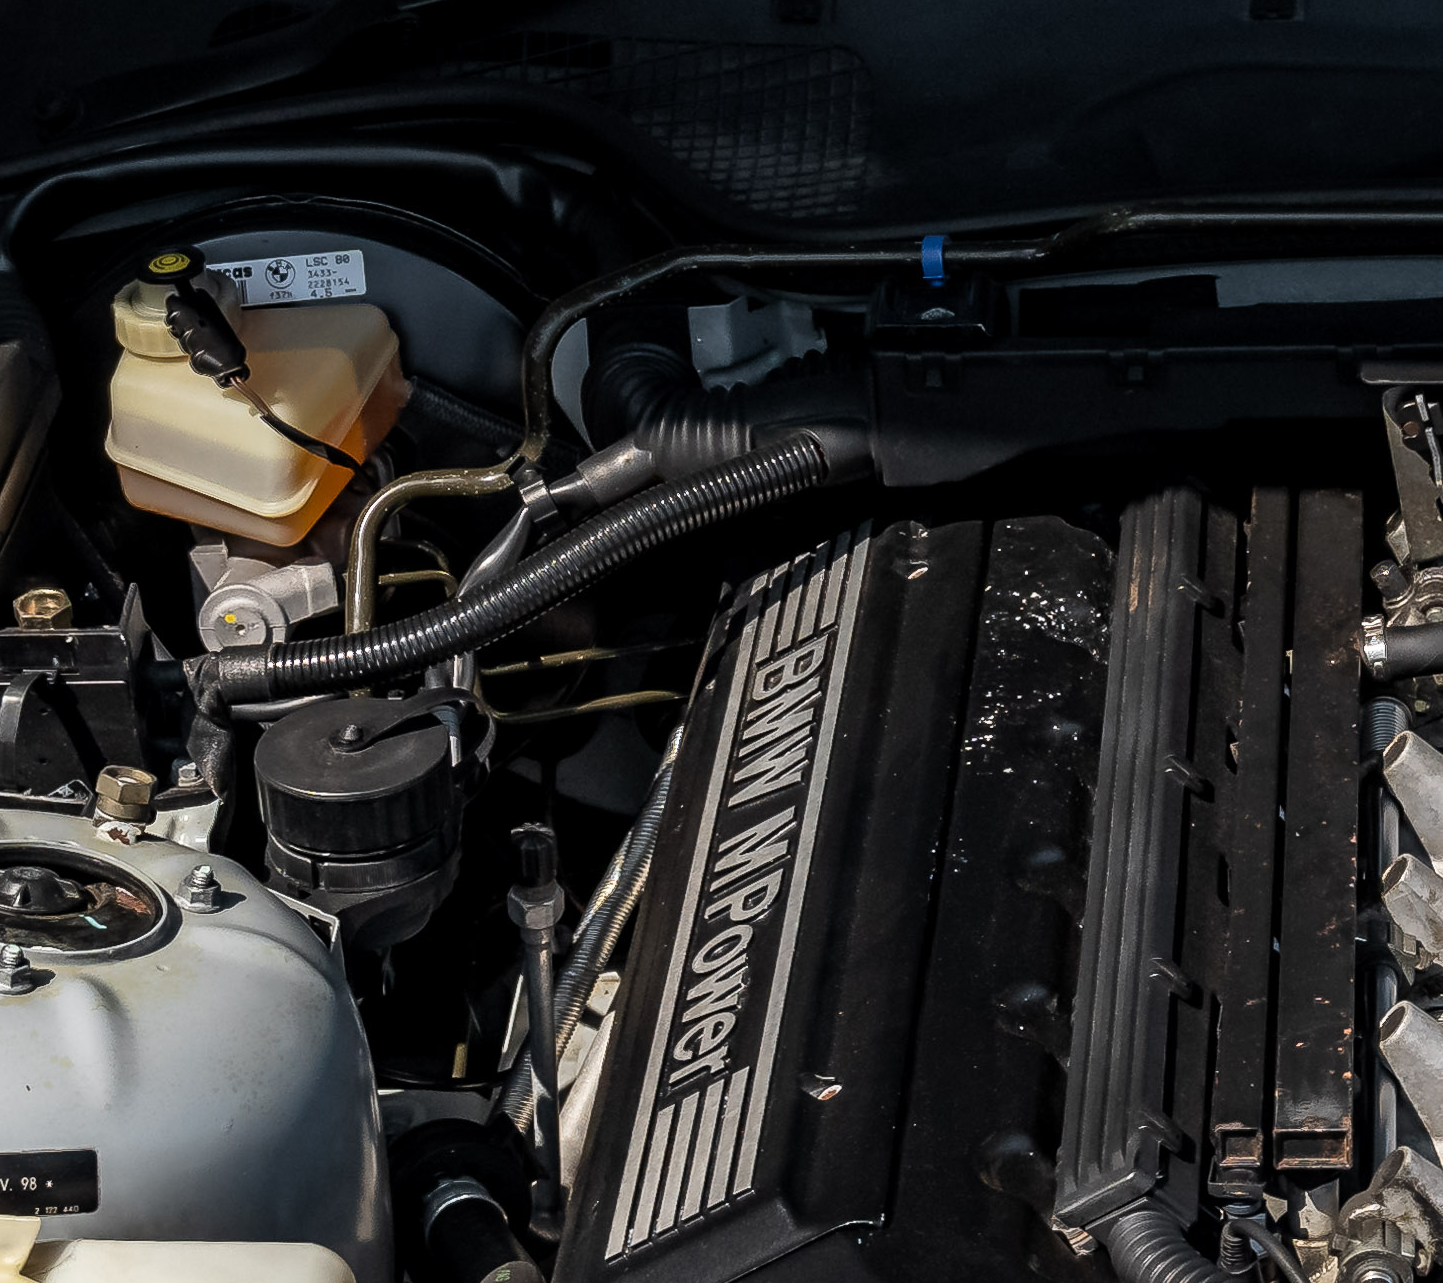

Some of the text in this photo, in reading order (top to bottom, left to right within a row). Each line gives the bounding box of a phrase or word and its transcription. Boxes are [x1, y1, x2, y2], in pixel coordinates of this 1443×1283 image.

[306, 254, 350, 267] LSC 80
[728, 637, 825, 808] BMW
[21, 1177, 37, 1190] 98
